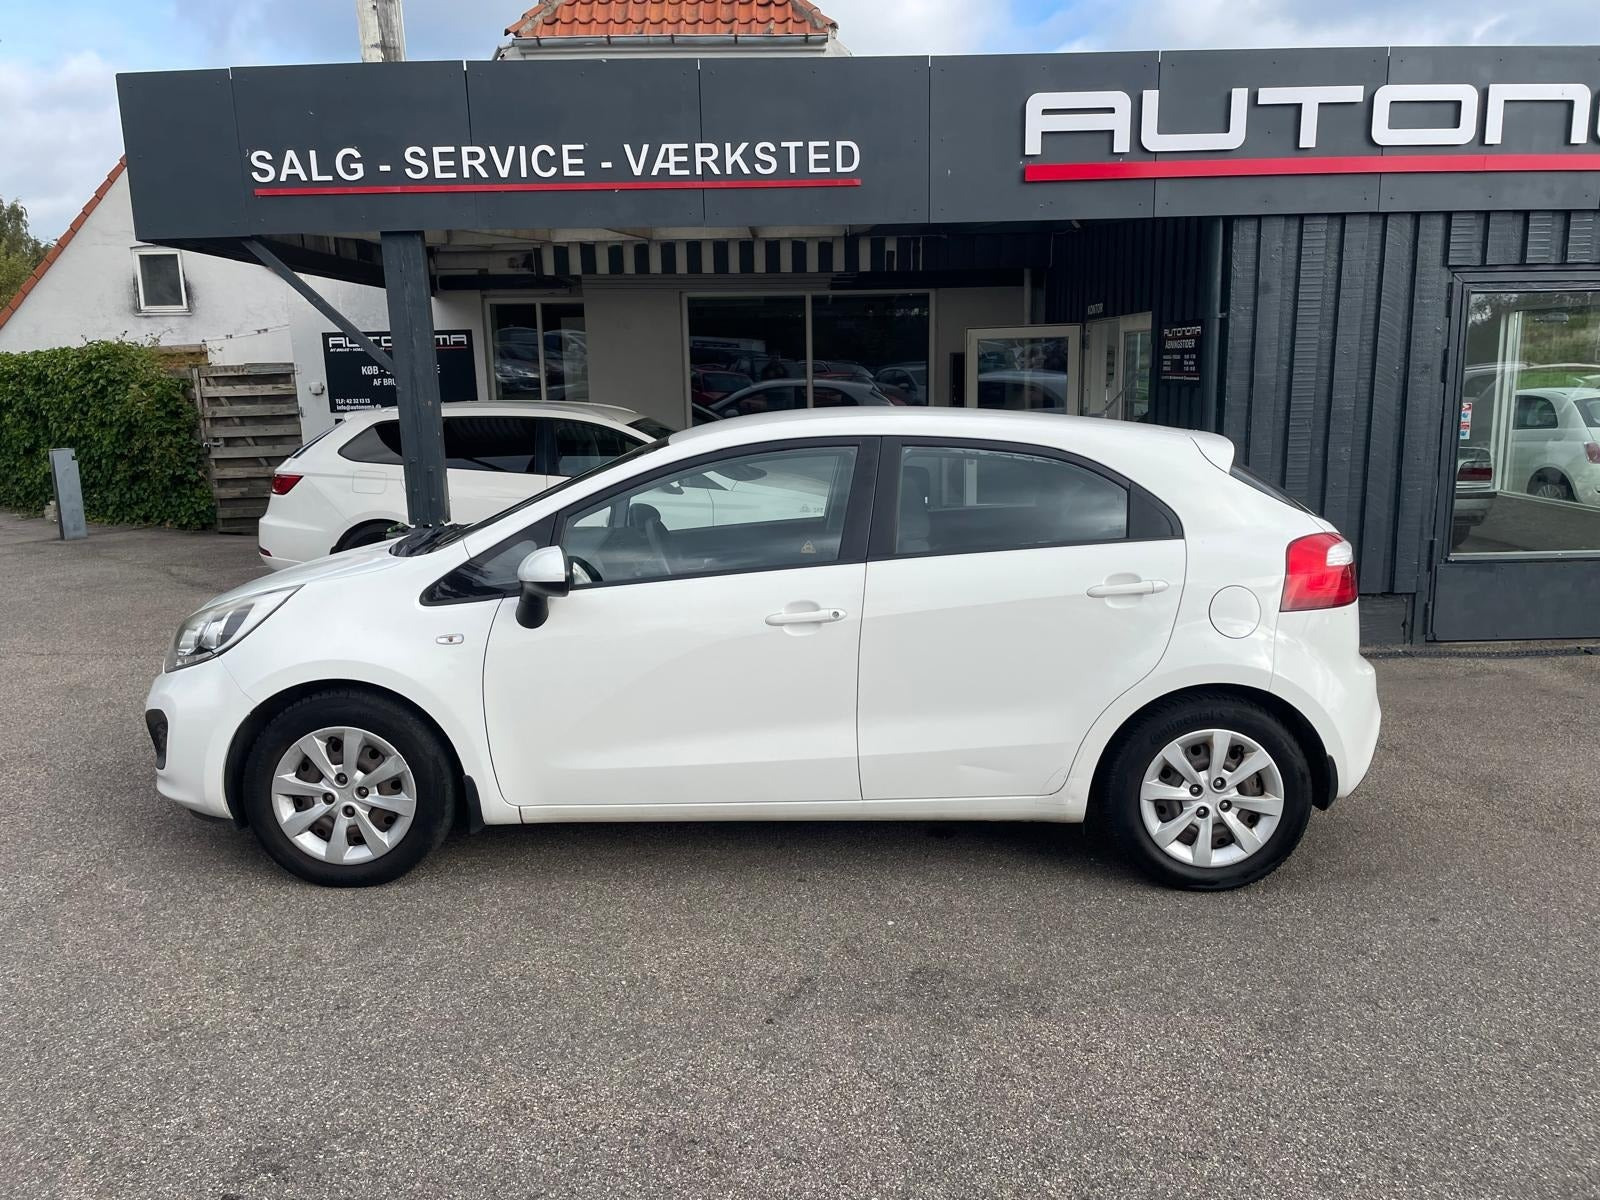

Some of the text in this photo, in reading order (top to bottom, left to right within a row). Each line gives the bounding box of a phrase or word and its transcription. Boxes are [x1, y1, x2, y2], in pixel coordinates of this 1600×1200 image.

[1025, 83, 1600, 155] AUTON
[250, 148, 365, 183] SALG
[404, 144, 585, 179] SERVICE
[623, 140, 860, 176] VÆRKSTED
[1163, 325, 1201, 337] AUTONOMA
[361, 366, 378, 375] KØB
[373, 378, 382, 386] AF
